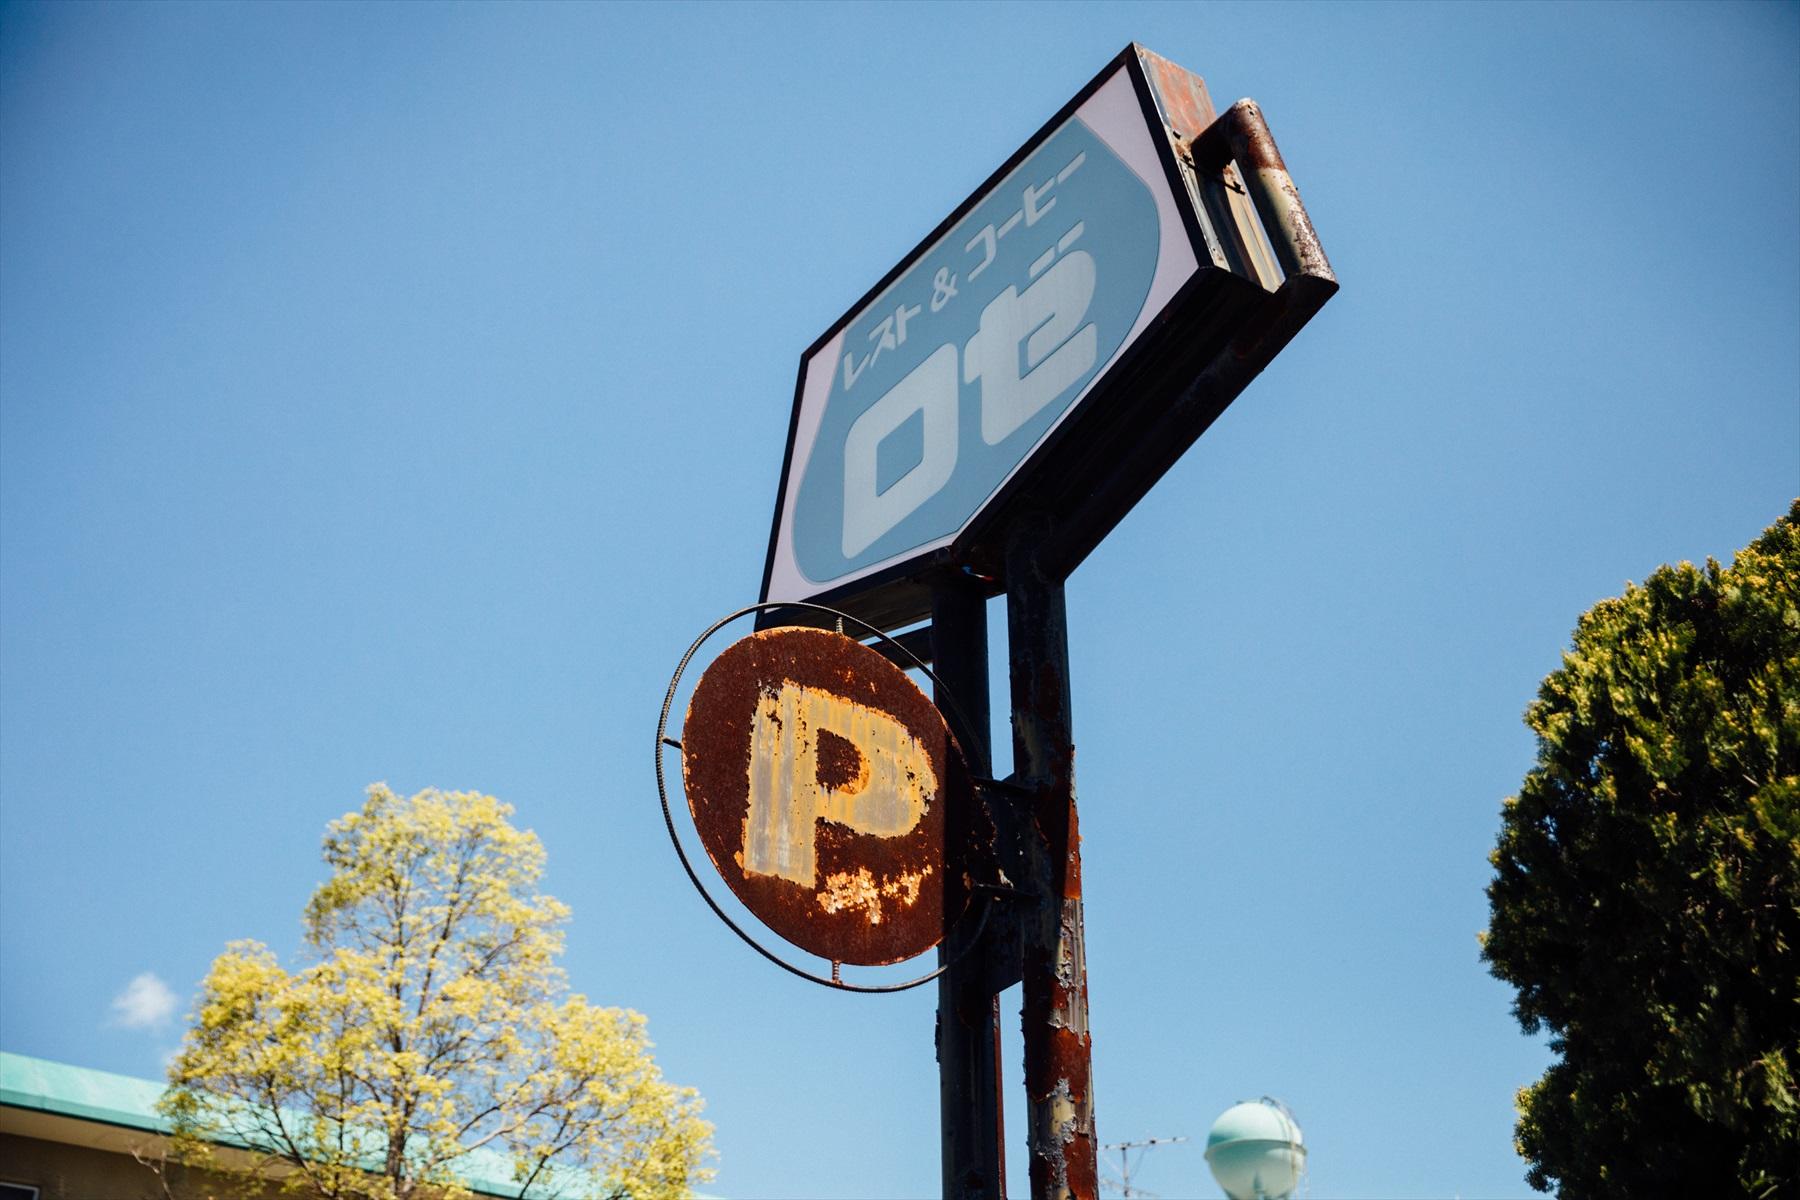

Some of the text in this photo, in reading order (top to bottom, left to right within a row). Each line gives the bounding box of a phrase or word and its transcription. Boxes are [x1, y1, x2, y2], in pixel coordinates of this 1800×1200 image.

[841, 219, 1098, 559] ロゼ
[843, 150, 1087, 391] レスト & コーヒー
[743, 678, 939, 889] P
